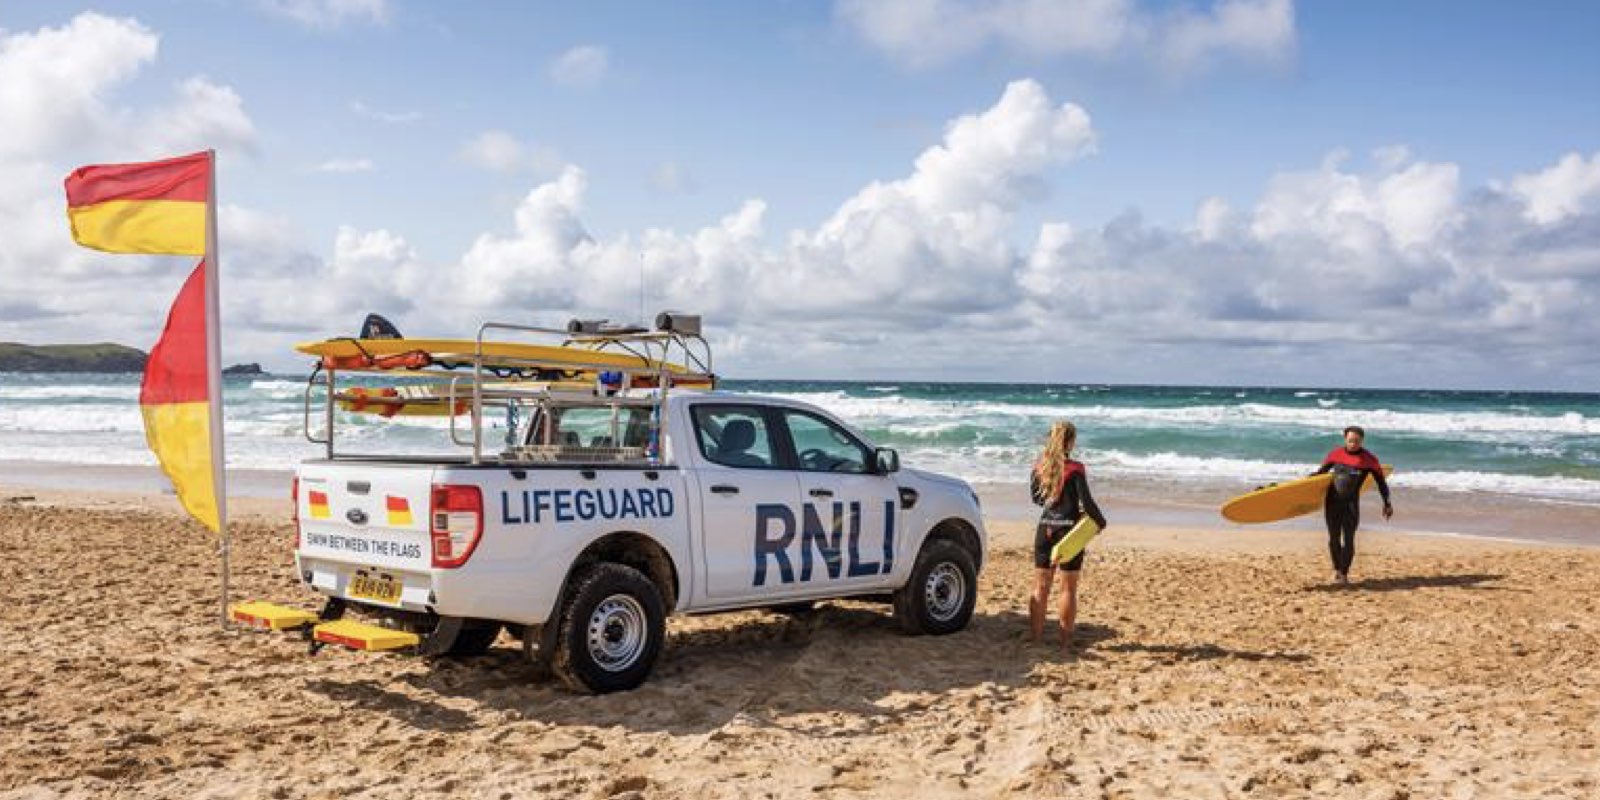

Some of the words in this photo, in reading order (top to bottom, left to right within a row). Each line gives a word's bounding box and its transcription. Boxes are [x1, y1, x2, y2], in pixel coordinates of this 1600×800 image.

[502, 488, 674, 524] LIFEGUARD
[329, 534, 369, 553] BETWEEN
[371, 540, 388, 556] THE
[390, 542, 422, 559] FLAGS
[752, 500, 895, 586] RNLI
